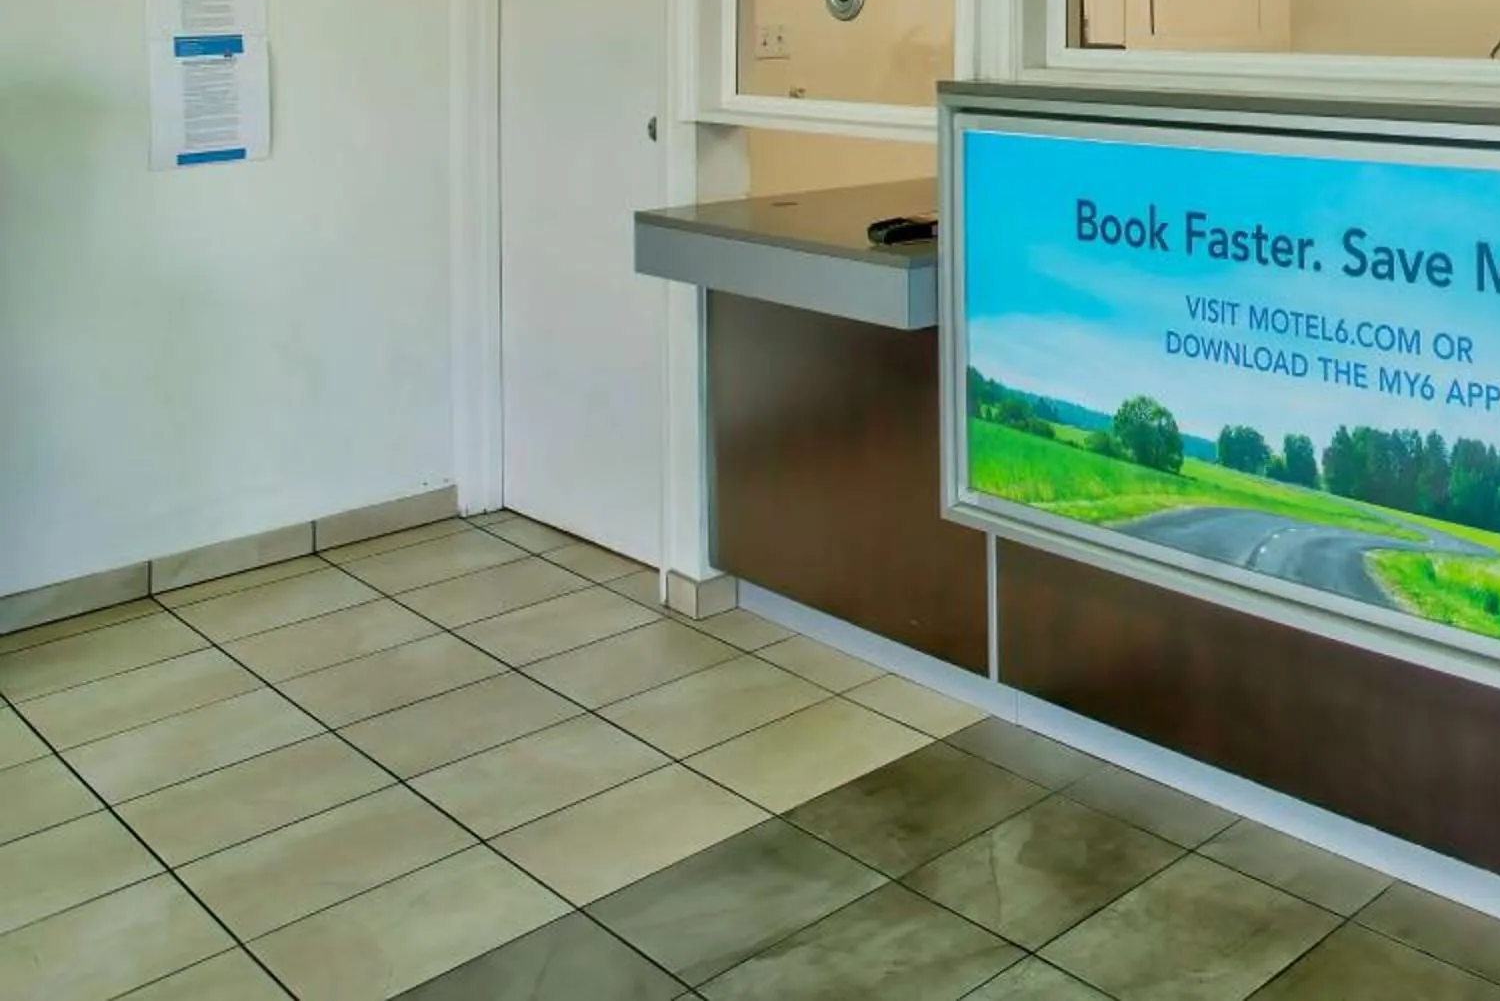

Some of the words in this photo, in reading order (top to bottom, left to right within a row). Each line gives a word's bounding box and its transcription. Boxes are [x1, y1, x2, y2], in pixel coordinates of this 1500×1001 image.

[1075, 198, 1170, 252] Book
[1184, 211, 1323, 272] Faster.
[1341, 227, 1454, 288] Save
[1185, 294, 1240, 328] VISIT
[1248, 305, 1422, 356] MOTEL6.COM
[1432, 331, 1473, 364] OR
[1165, 330, 1309, 379] DOWNLOAD
[1317, 355, 1368, 389] THE
[1378, 366, 1435, 403] MY6
